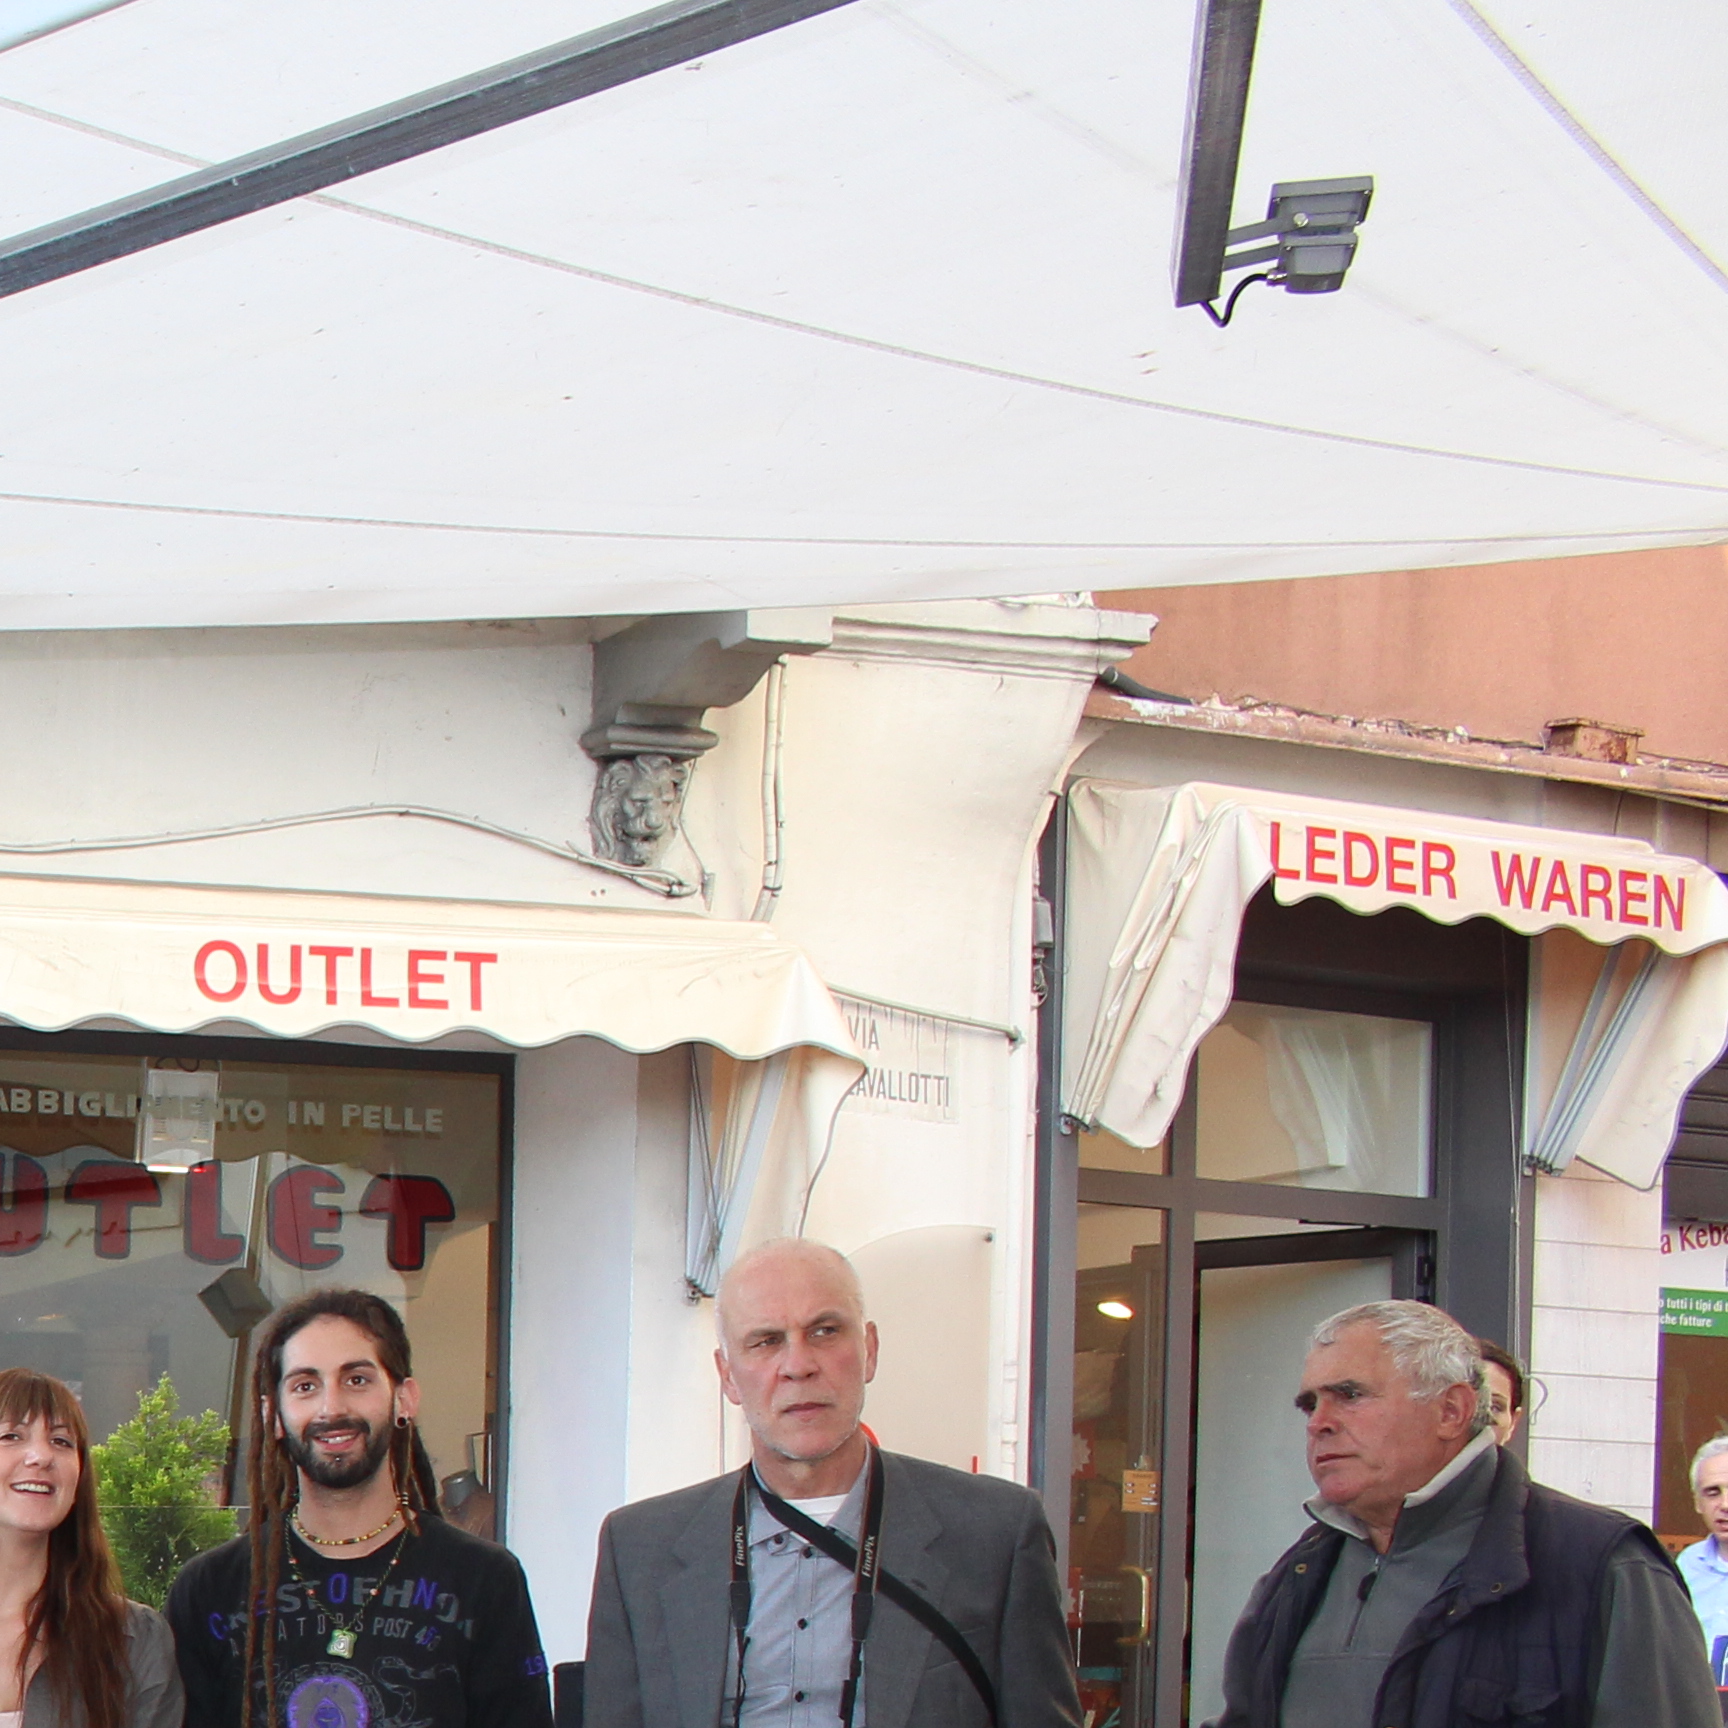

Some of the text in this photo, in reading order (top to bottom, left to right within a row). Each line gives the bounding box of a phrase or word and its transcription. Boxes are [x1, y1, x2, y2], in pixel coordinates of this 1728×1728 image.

[1270, 821, 1687, 932] LEDER WAREN
[194, 939, 498, 1012] OUTLET
[847, 1014, 880, 1051] VIA
[848, 1066, 950, 1108] AVALLOTTI
[288, 1101, 325, 1126] IN
[342, 1104, 444, 1134] PELLE
[1666, 1297, 1688, 1310] tutti
[1695, 1298, 1712, 1315] tipi
[1679, 1313, 1713, 1328] fatture
[734, 1524, 744, 1568] FinePix
[860, 1534, 876, 1579] FinePix
